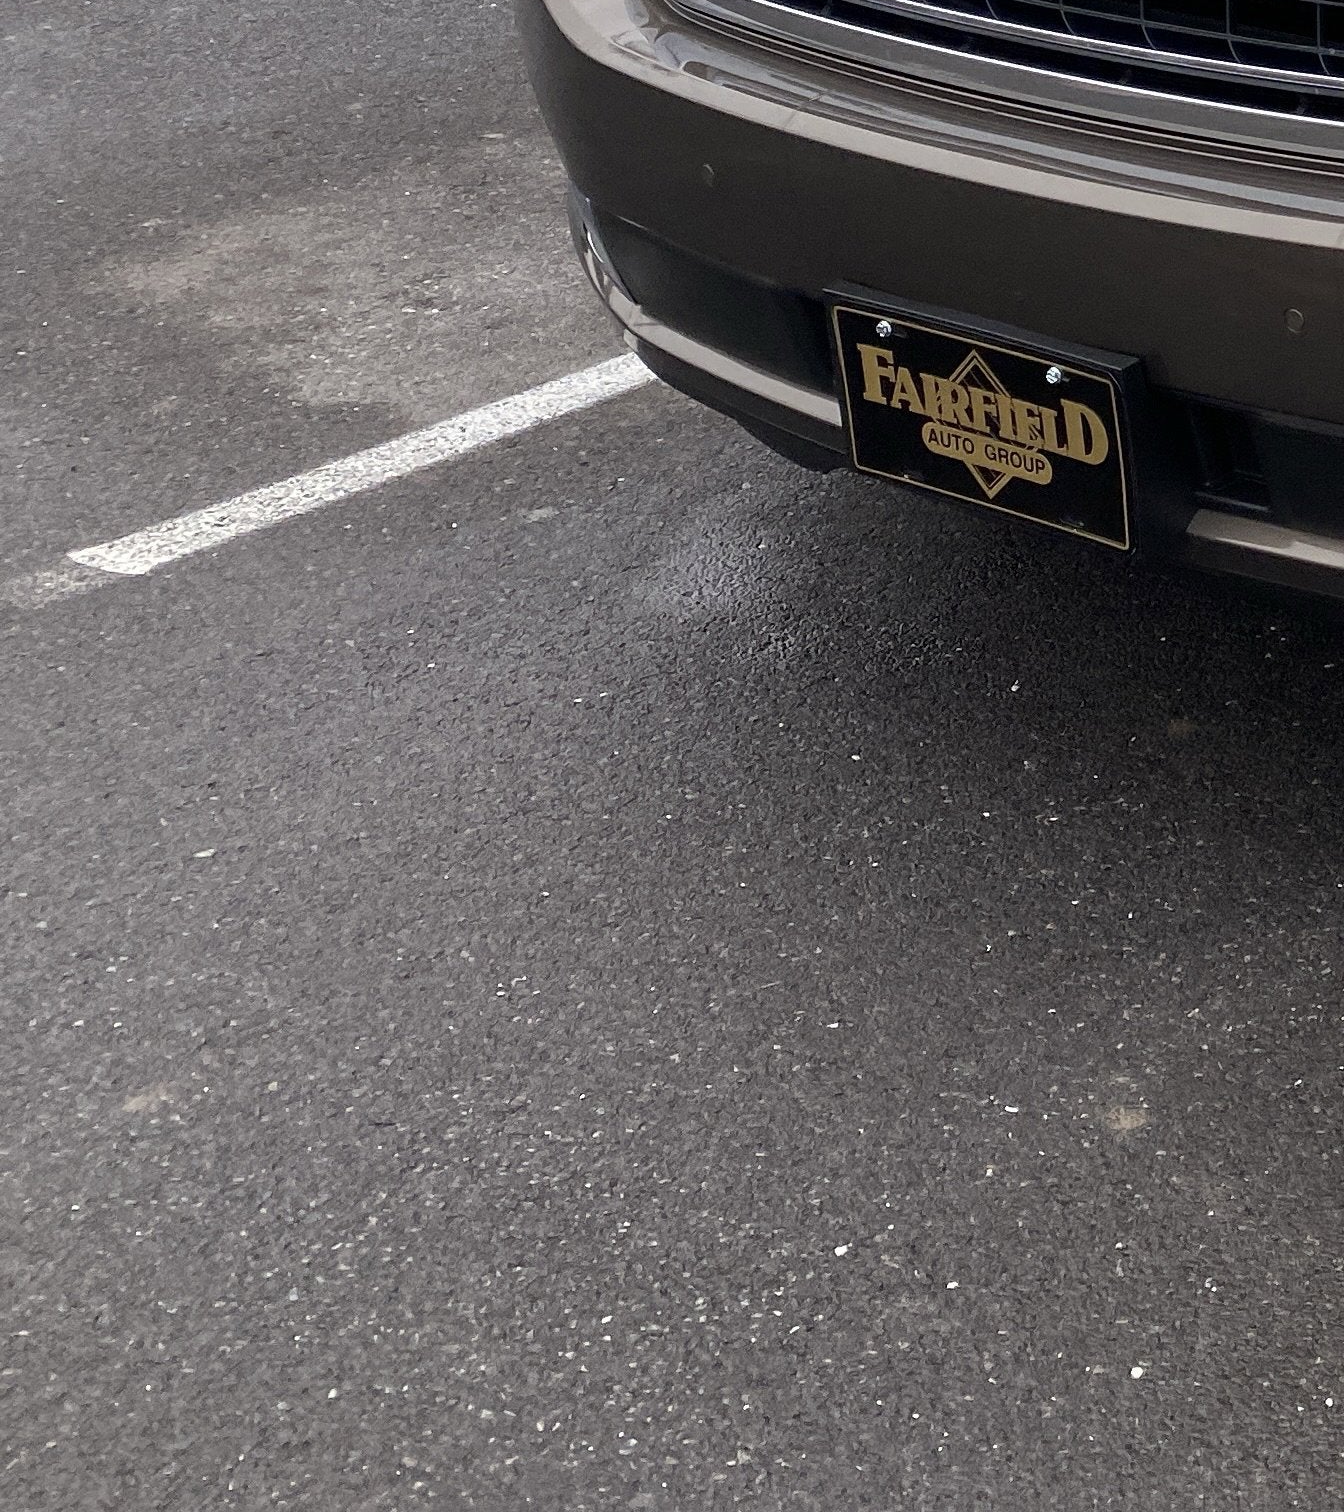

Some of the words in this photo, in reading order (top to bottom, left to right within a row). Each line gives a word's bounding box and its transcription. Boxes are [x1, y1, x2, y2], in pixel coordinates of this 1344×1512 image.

[856, 343, 1109, 466] FAIRFIELD
[927, 428, 975, 456] AUTO
[984, 444, 1046, 476] GROUP
